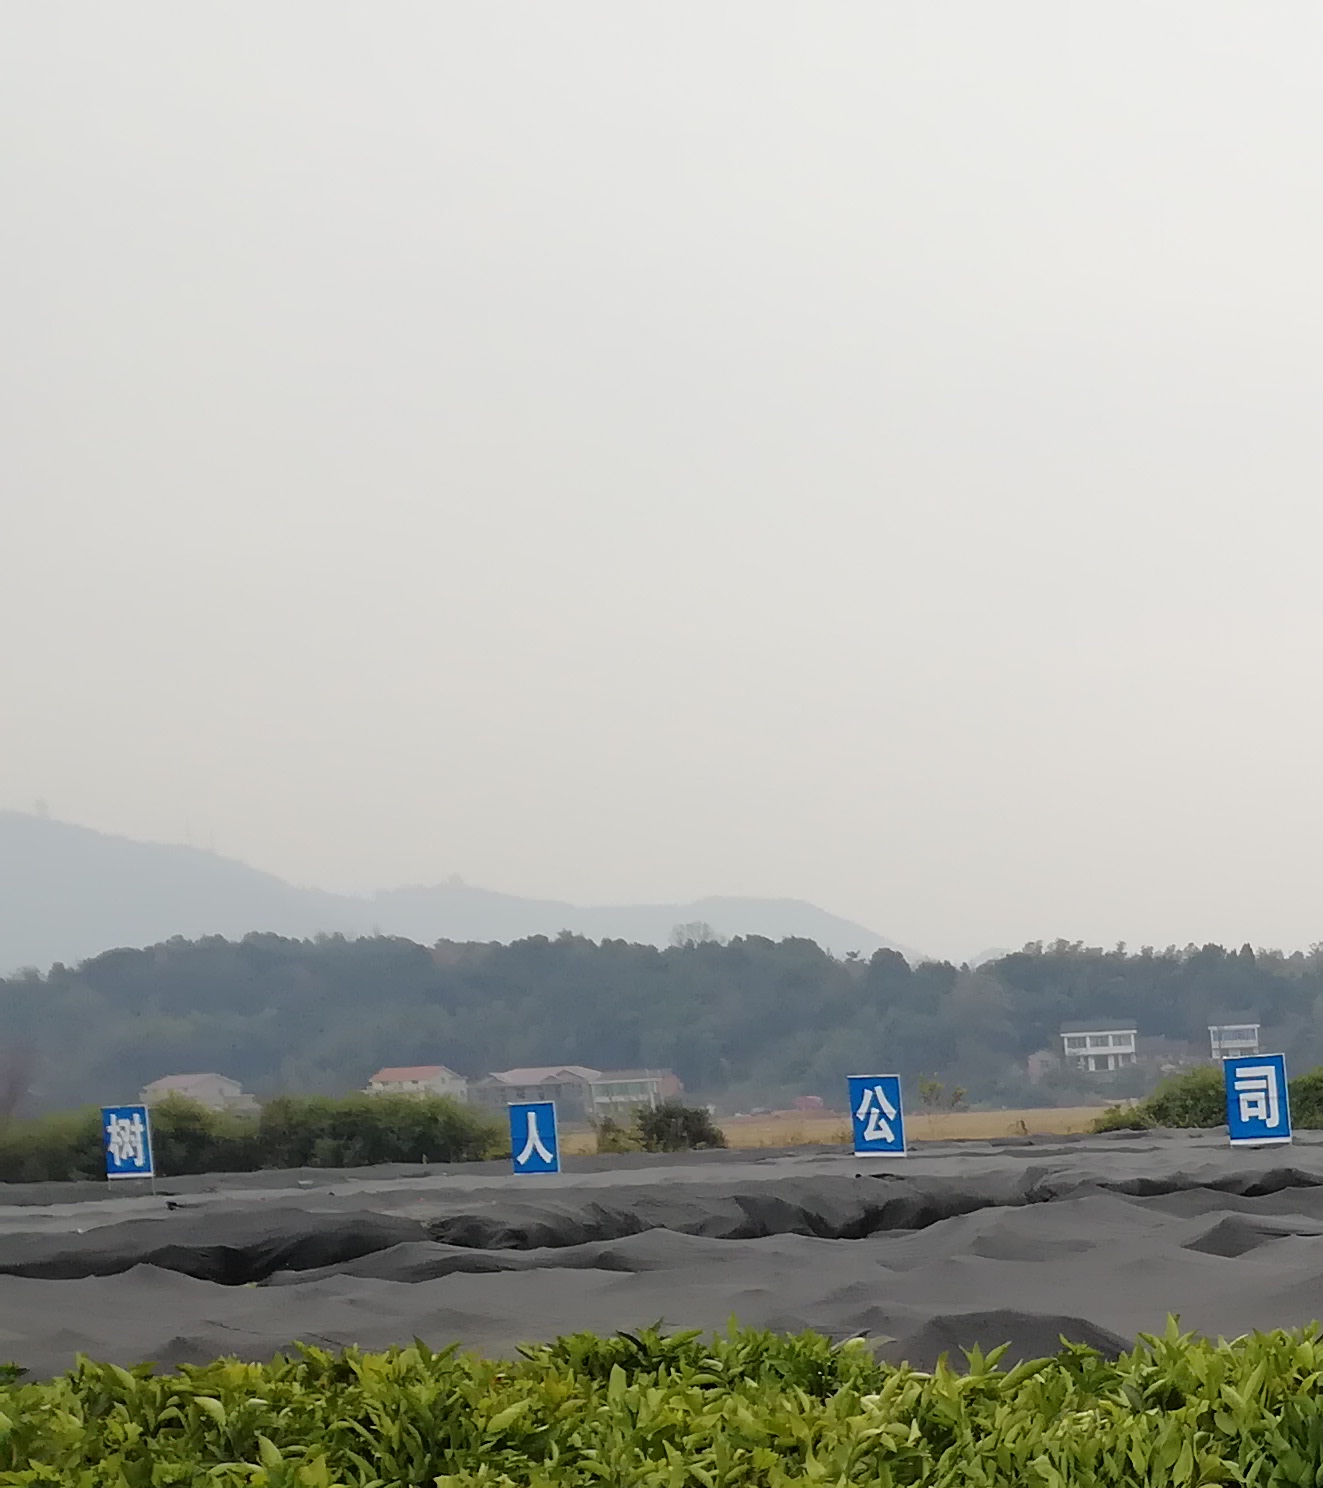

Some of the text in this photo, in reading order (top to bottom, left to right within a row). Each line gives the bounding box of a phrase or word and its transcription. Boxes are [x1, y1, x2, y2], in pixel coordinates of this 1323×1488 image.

[857, 1085, 897, 1143] 公
[1234, 1066, 1279, 1128] 司
[107, 1113, 145, 1167] 树
[517, 1111, 553, 1165] 人
